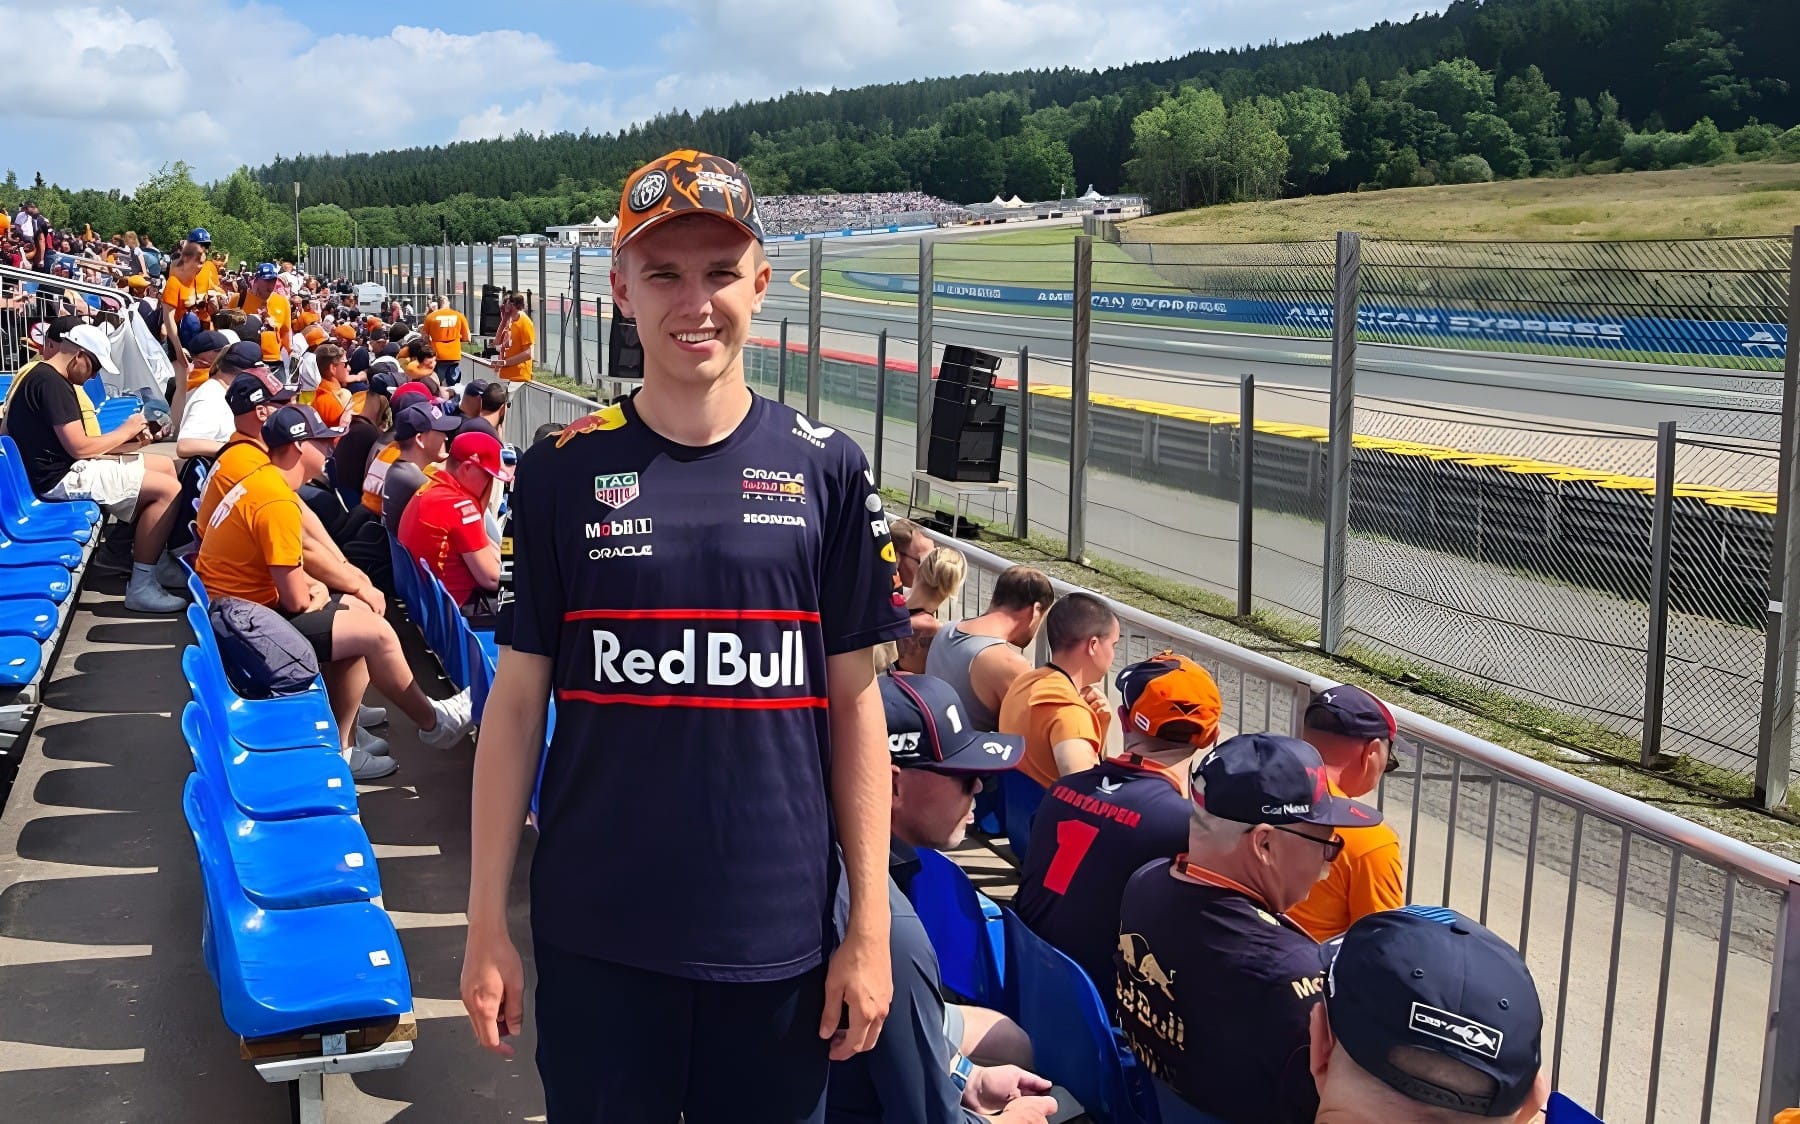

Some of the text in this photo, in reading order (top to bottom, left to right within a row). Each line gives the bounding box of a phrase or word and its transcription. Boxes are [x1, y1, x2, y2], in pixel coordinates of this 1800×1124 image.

[599, 475, 635, 489] TAG
[585, 519, 633, 539] Mobil
[743, 513, 807, 527] HONDA
[588, 544, 653, 560] ORACLE
[593, 628, 804, 688] Red Bull
[1042, 819, 1100, 896] 1
